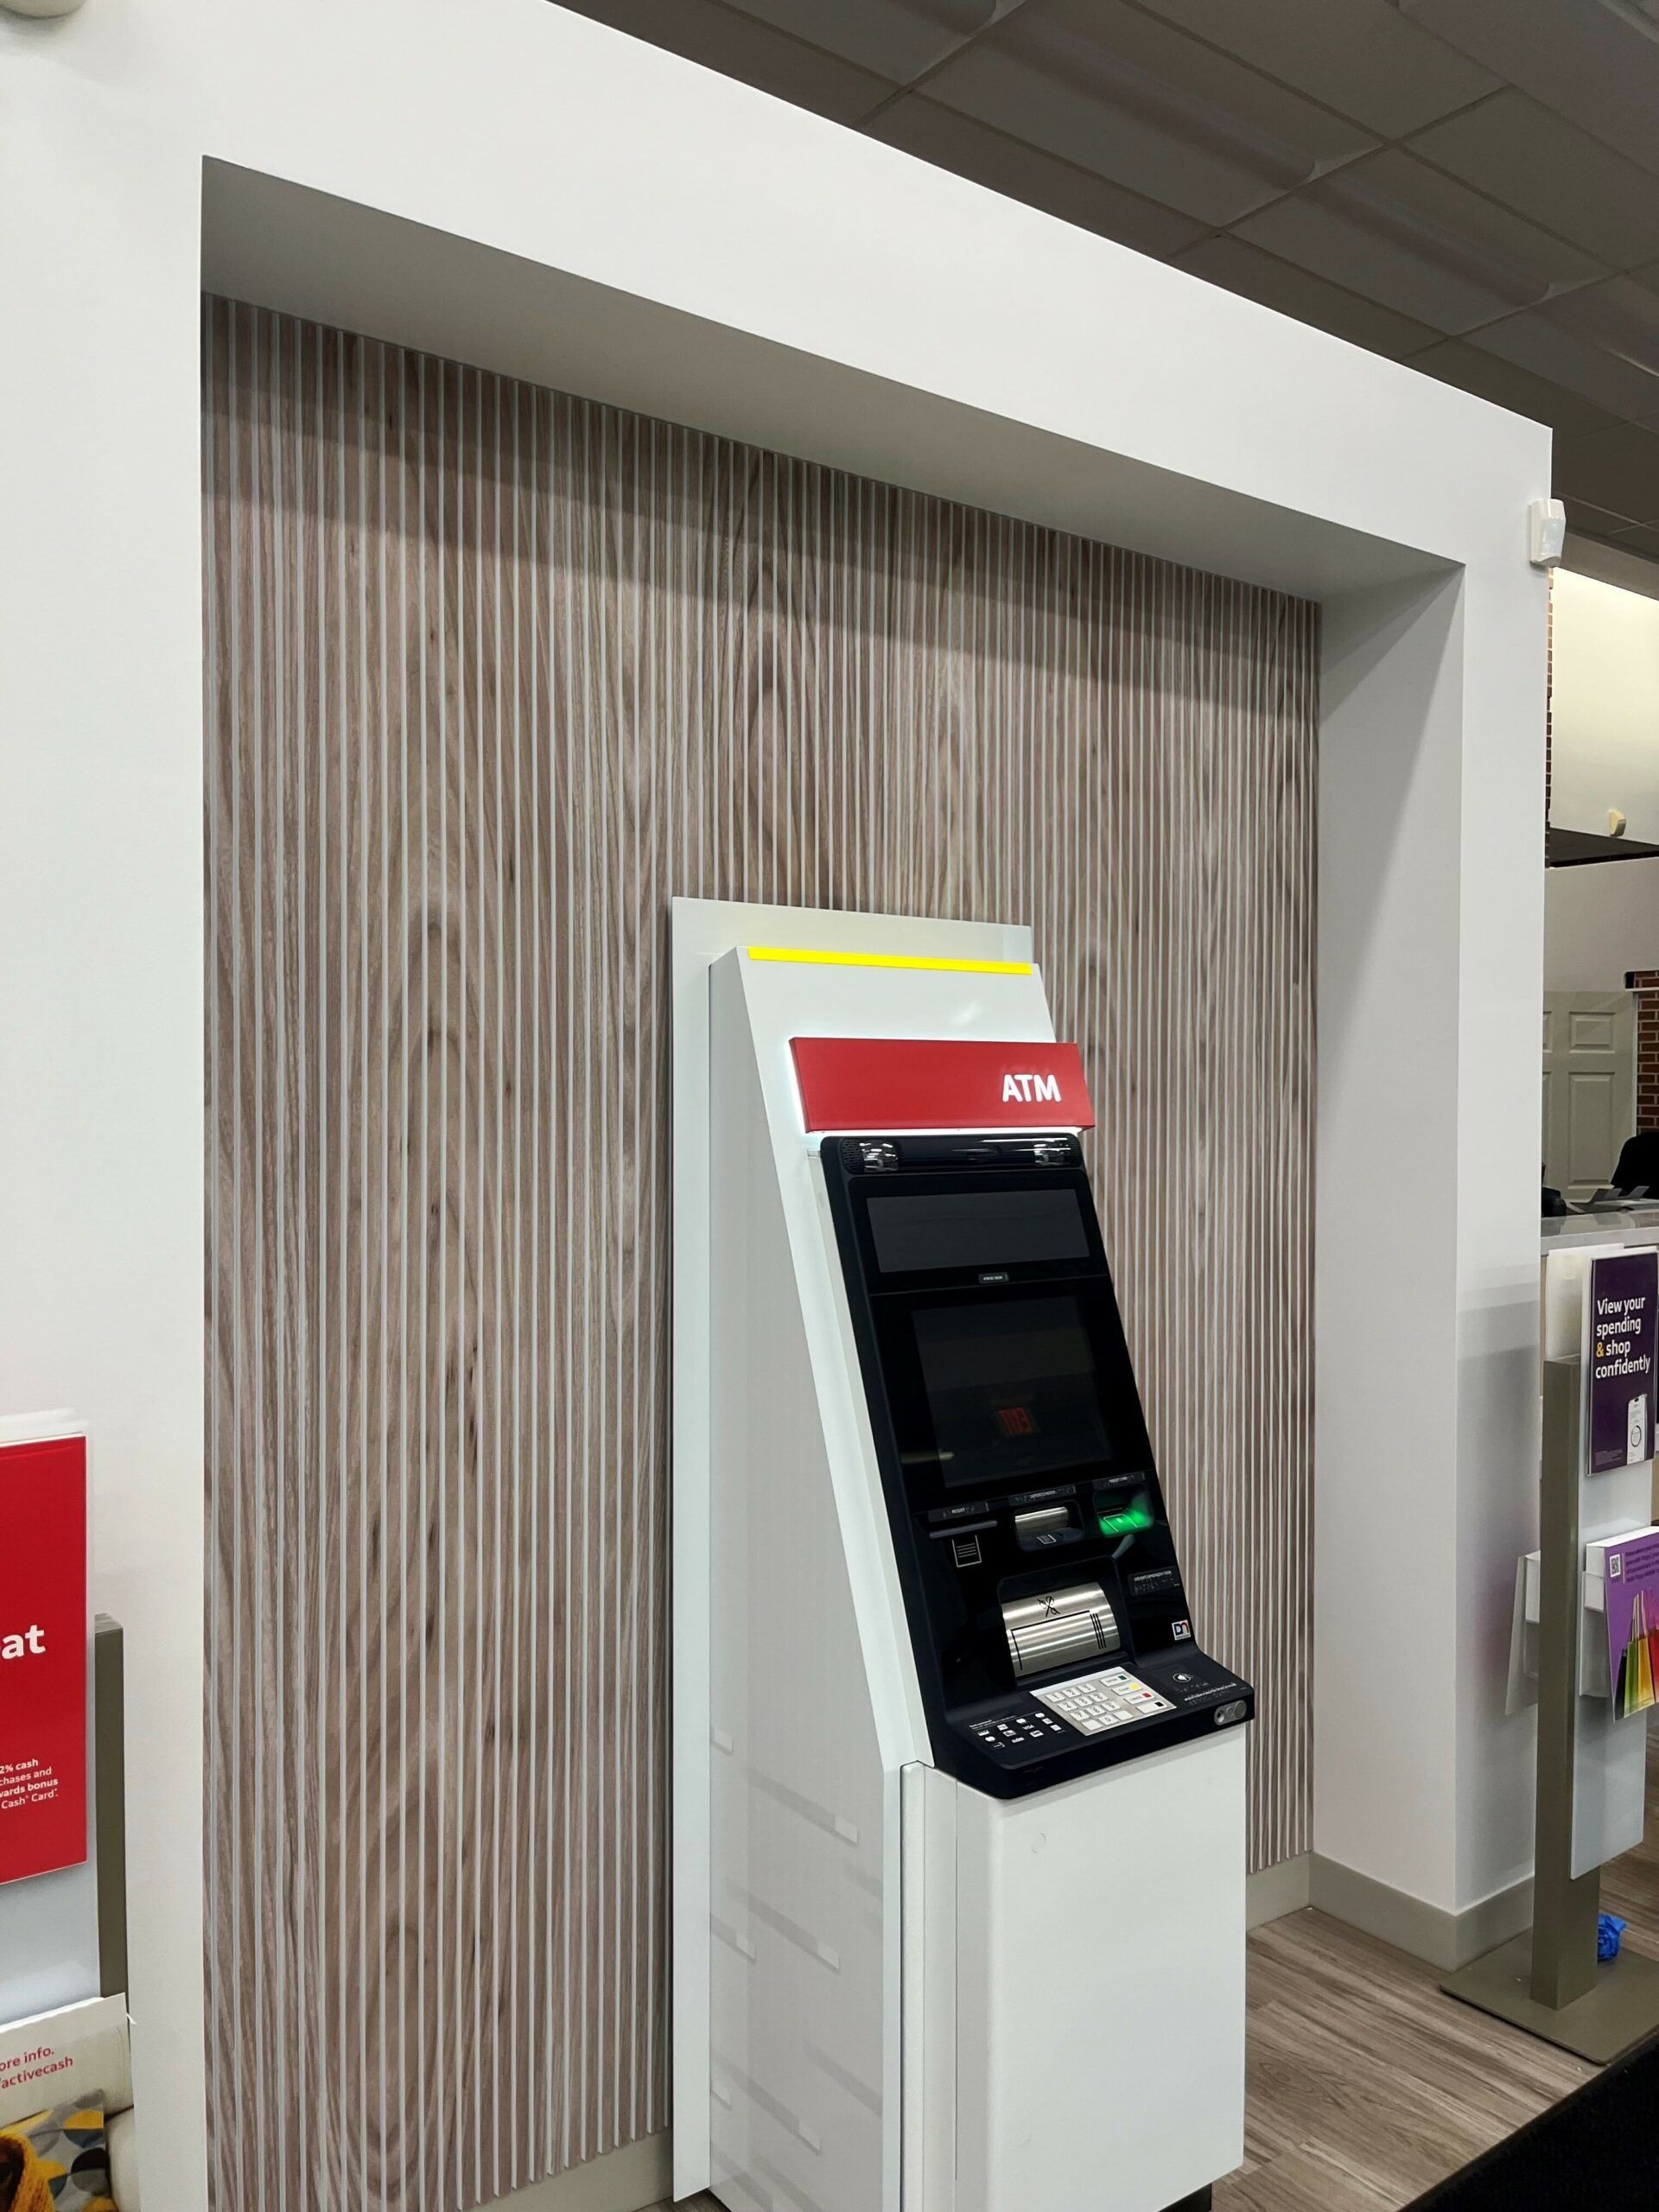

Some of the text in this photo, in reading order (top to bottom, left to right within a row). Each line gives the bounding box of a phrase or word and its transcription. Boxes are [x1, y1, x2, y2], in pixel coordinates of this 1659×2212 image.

[1002, 1074, 1062, 1103] ATM
[1597, 1297, 1646, 1316] View your
[1596, 1315, 1642, 1340] spending
[1596, 1339, 1630, 1357] & shop
[1595, 1354, 1651, 1379] confidently
[0, 1624, 46, 1659] at
[0, 1758, 39, 1774] 2% cash
[34, 1766, 52, 1778] and
[28, 1778, 59, 1791] bonus
[24, 2046, 54, 2063] info.
